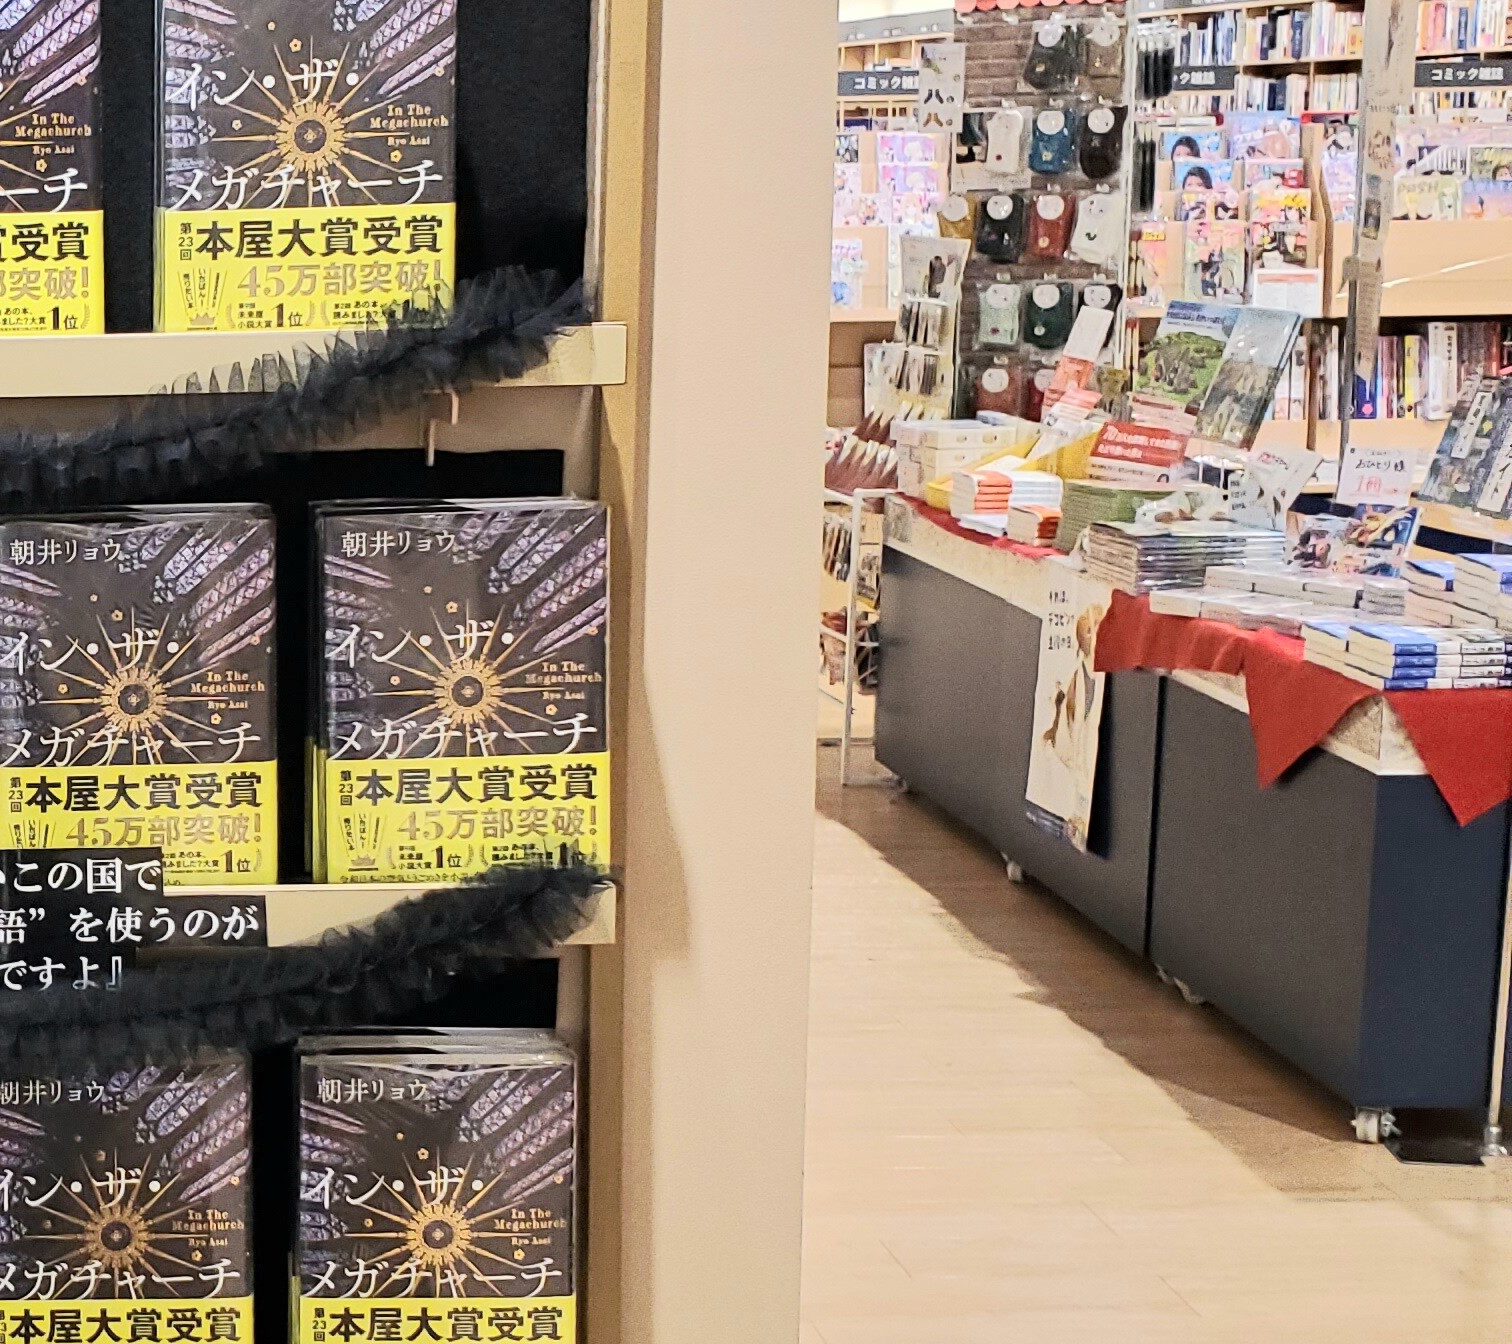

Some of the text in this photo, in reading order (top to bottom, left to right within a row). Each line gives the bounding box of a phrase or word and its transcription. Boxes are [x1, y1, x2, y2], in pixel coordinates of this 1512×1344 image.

[854, 75, 919, 90] コミック雑
[1432, 67, 1504, 81] コミック雑誌
[32, 113, 75, 124] In The
[196, 216, 443, 260] 本屋大賞受賞
[341, 531, 456, 557] 朝井リョウ
[1, 722, 260, 766] メガチャーチ
[10, 1308, 241, 1344] 本屋大賞受賞
